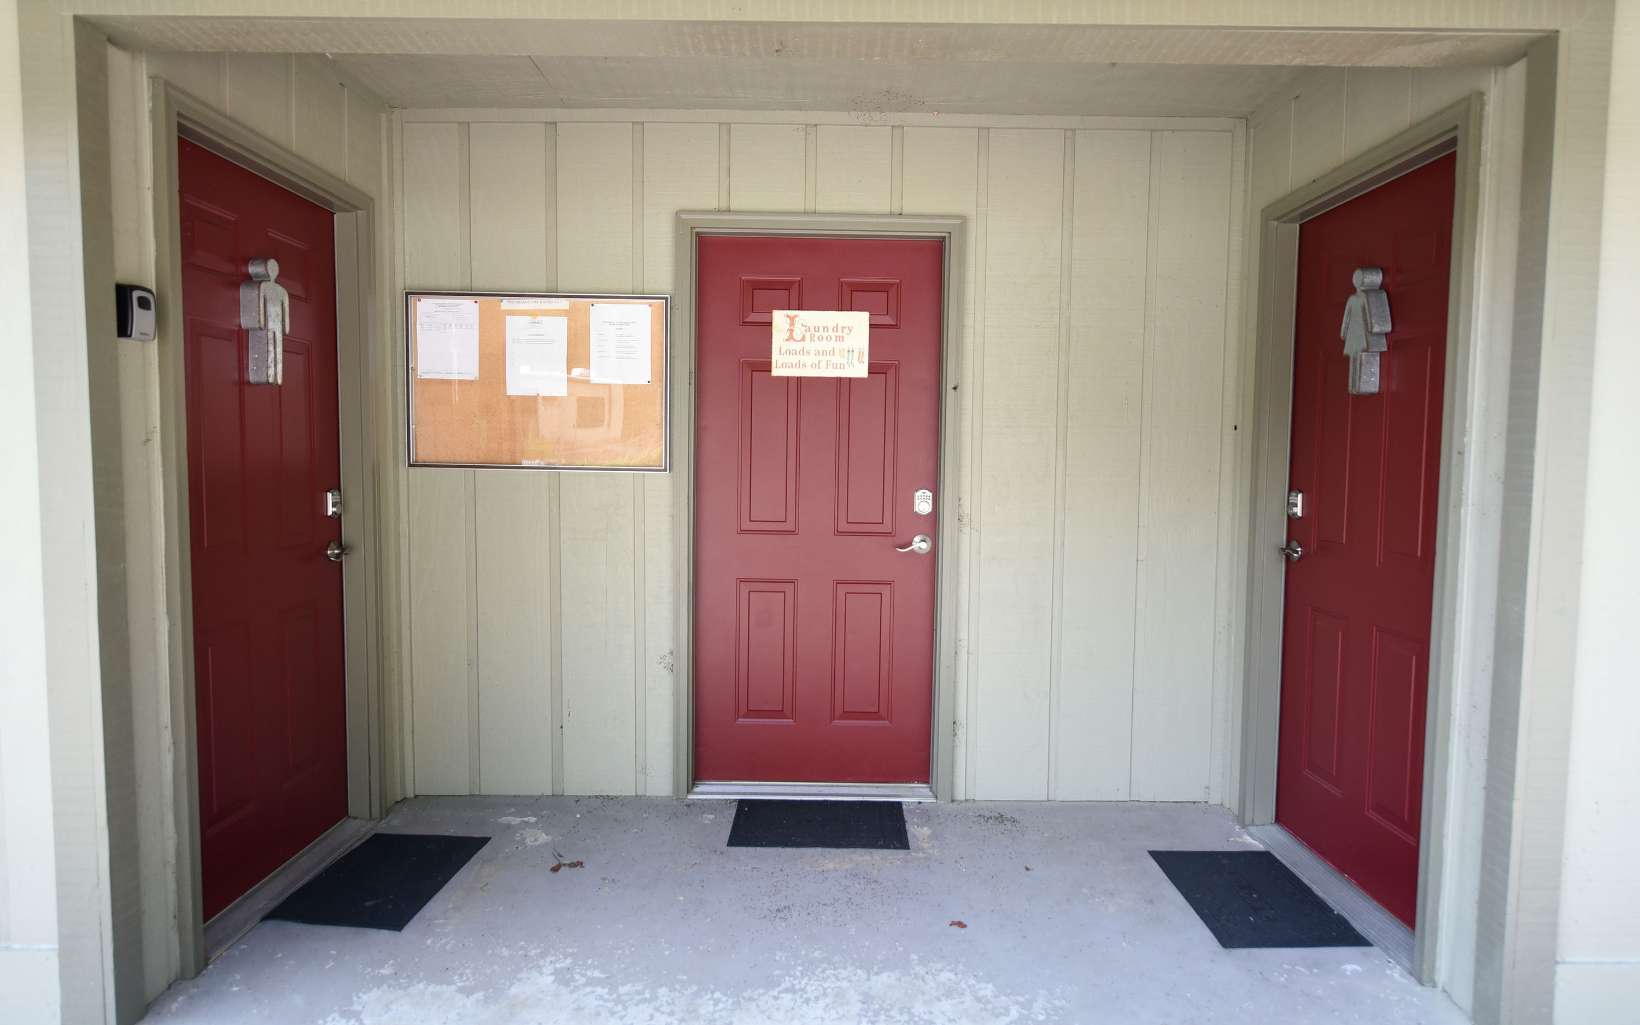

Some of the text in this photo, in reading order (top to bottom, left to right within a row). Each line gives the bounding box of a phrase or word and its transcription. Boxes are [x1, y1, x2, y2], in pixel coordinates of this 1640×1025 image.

[785, 314, 854, 342] Laundry
[809, 333, 845, 342] Room
[778, 346, 836, 356] Loads and
[775, 359, 846, 370] Loads of Fun
